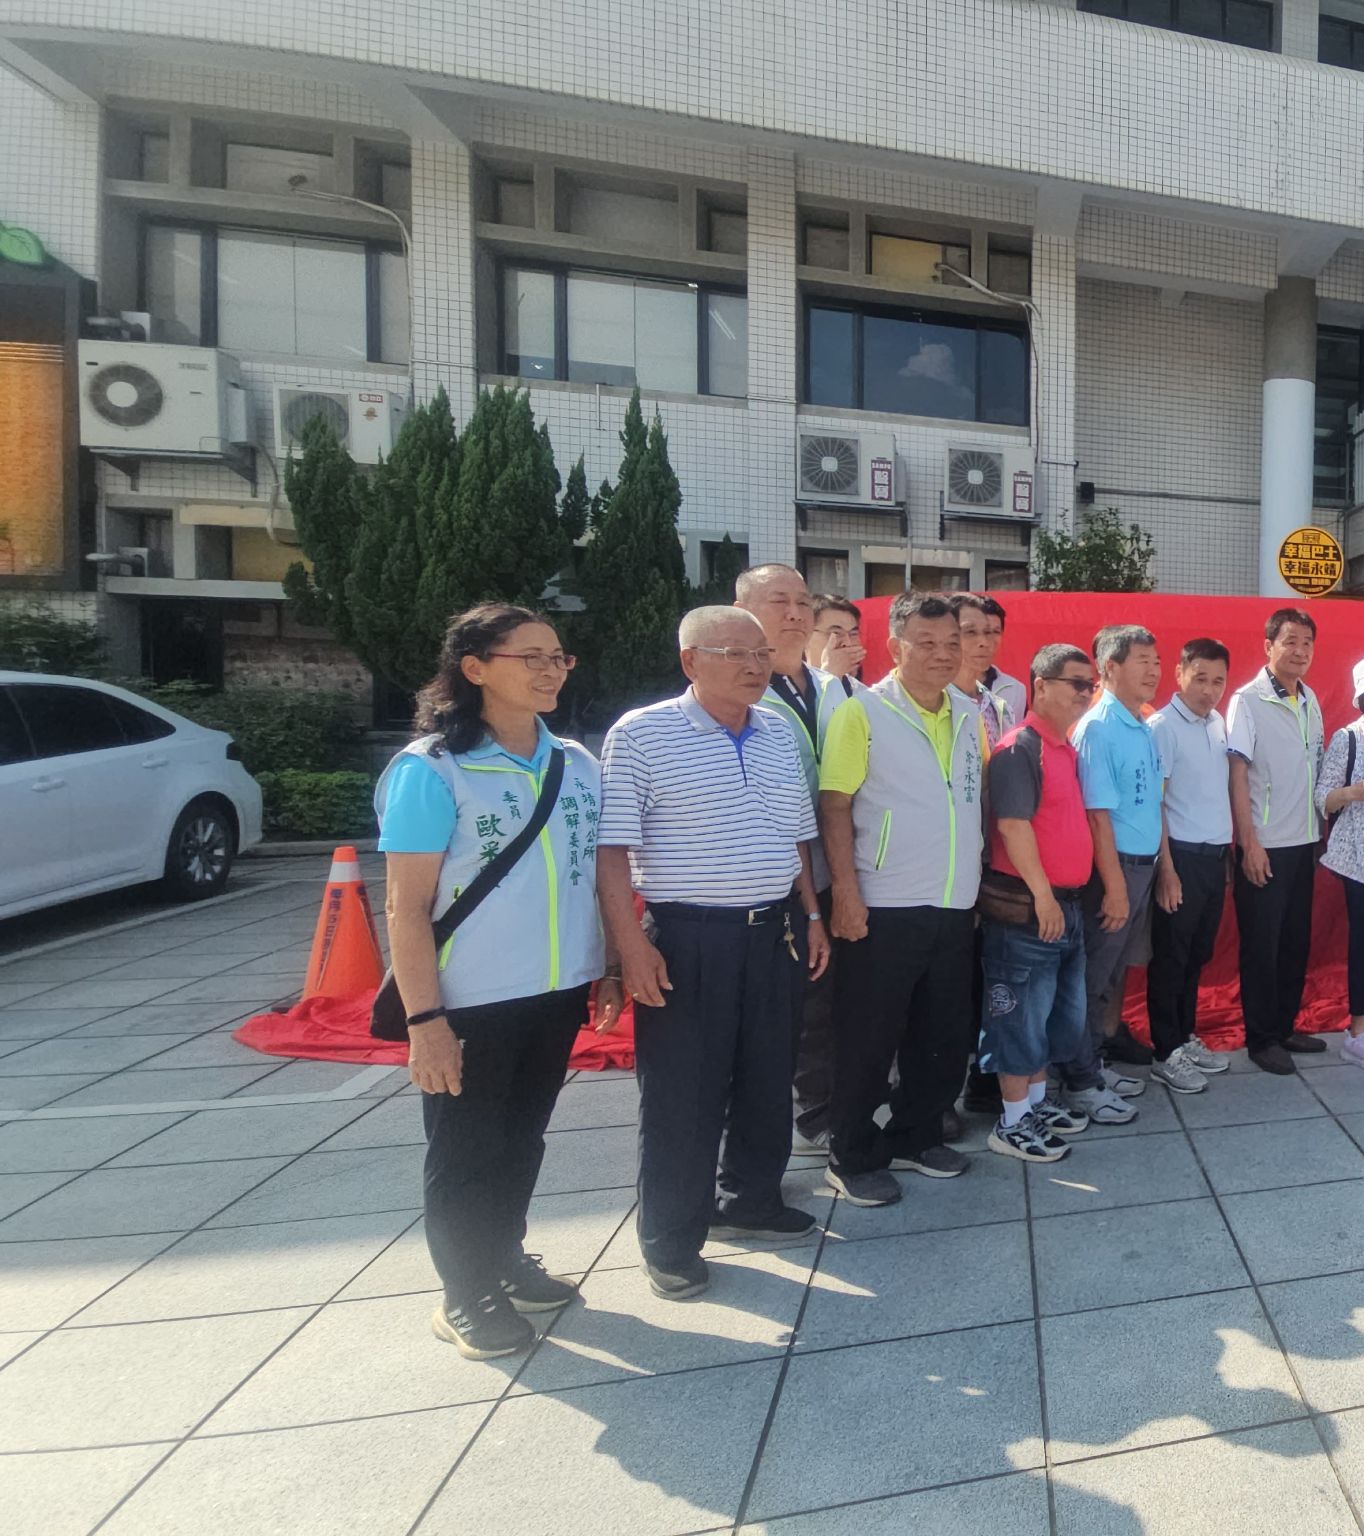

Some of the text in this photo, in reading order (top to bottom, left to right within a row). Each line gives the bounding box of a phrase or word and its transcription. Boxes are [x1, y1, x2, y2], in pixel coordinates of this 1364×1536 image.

[1284, 544, 1338, 560] 幸福巴士
[1284, 561, 1337, 577] 幸福永靖
[502, 790, 522, 819] 委員
[574, 778, 599, 861] 永靖鄉公所
[475, 814, 508, 876] 歐采
[560, 796, 582, 886] 調解委員會
